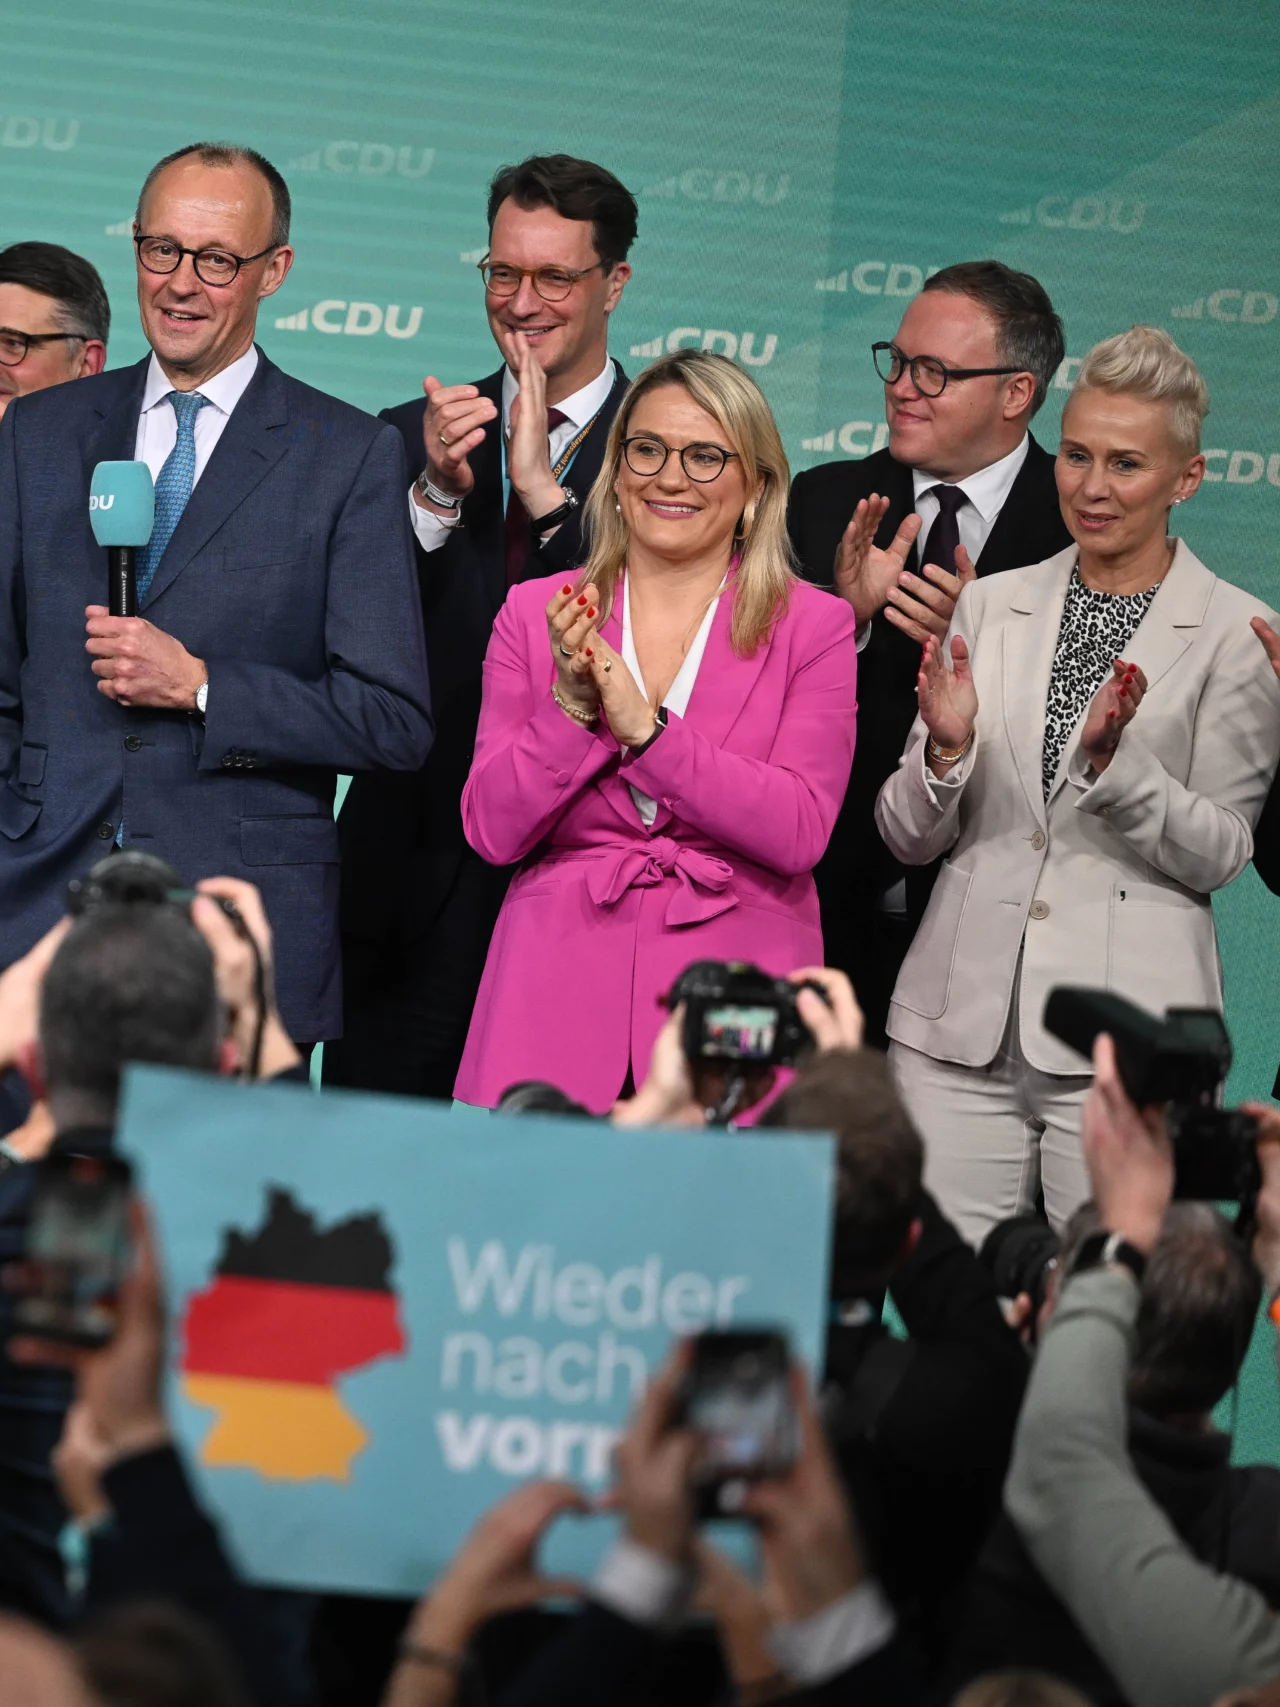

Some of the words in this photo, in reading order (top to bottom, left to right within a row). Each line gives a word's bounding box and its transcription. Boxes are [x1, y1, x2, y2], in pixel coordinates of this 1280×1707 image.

[323, 140, 437, 178] CDU
[680, 169, 791, 205] CDU
[1036, 196, 1146, 234] CDU
[852, 261, 941, 296] CD
[312, 300, 424, 339] CDU
[1208, 289, 1278, 324] CD
[665, 326, 778, 366] CDU
[89, 494, 115, 511] DU
[447, 1235, 751, 1333] Wieder
[441, 1329, 647, 1405] nach
